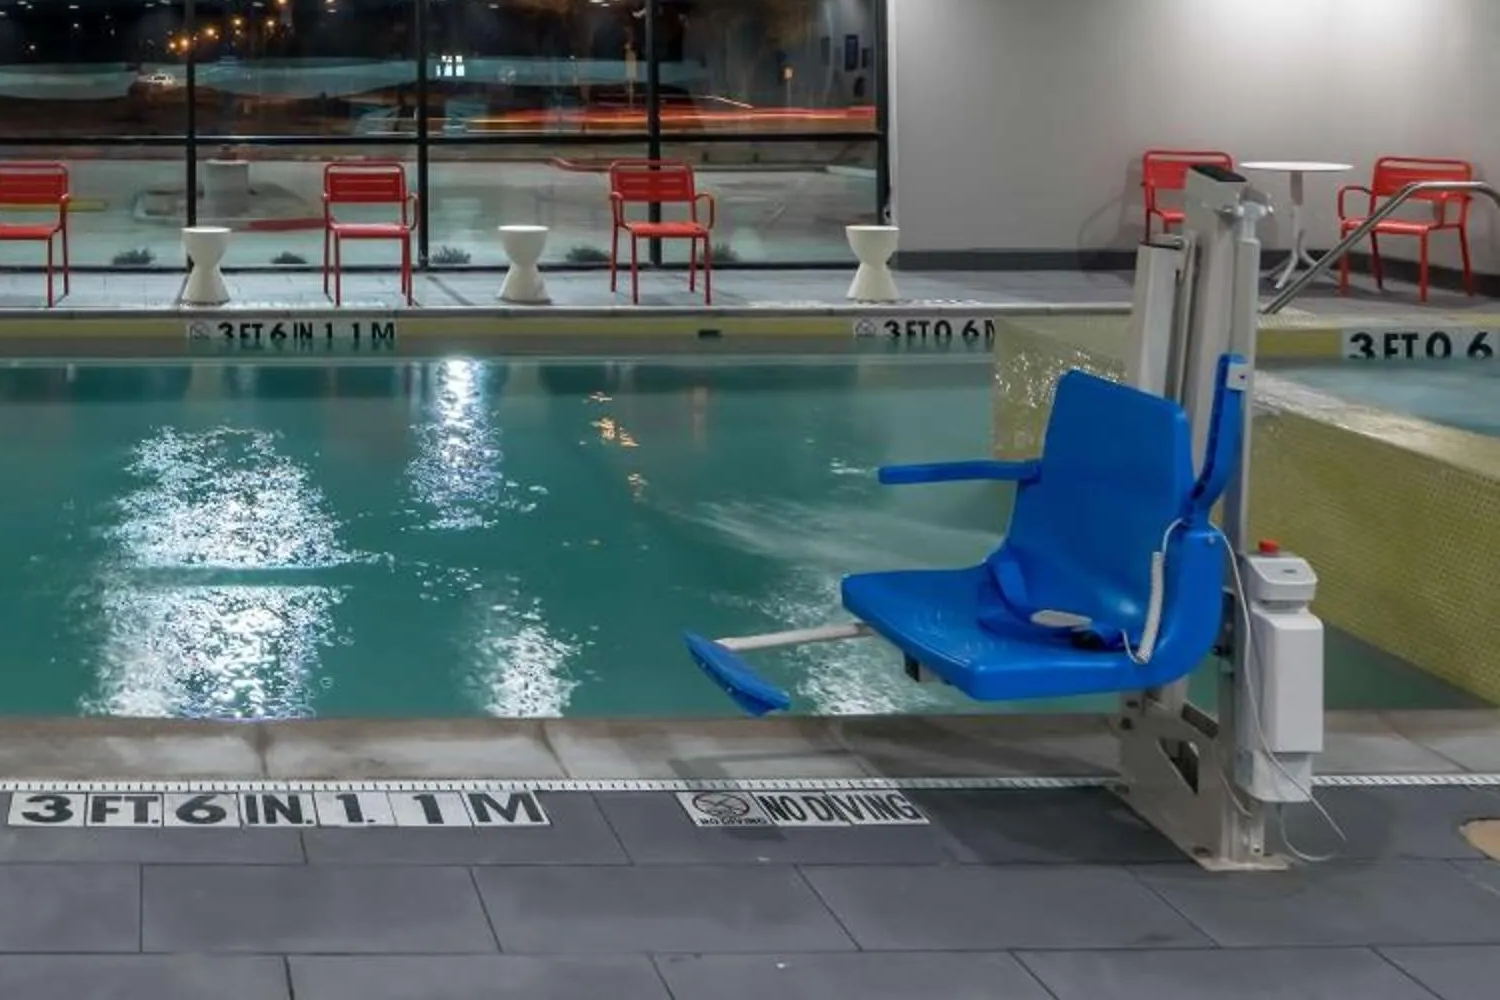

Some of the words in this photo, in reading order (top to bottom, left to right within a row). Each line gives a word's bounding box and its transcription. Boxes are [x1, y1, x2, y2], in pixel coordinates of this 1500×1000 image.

[218, 322, 234, 339] 3
[240, 323, 263, 339] FT
[270, 322, 287, 339] 6
[294, 322, 313, 339] IN
[371, 322, 395, 339] M
[884, 319, 900, 337] 3
[906, 319, 930, 337] FT
[1349, 331, 1375, 360] 3
[1384, 333, 1418, 360] FT
[22, 794, 74, 823] 3
[91, 795, 159, 824] FT.
[176, 794, 227, 824] 6
[245, 794, 313, 825] IN.
[413, 794, 444, 825] 1
[467, 793, 545, 823] M
[757, 794, 808, 822] NO
[802, 793, 923, 822] DIVING
